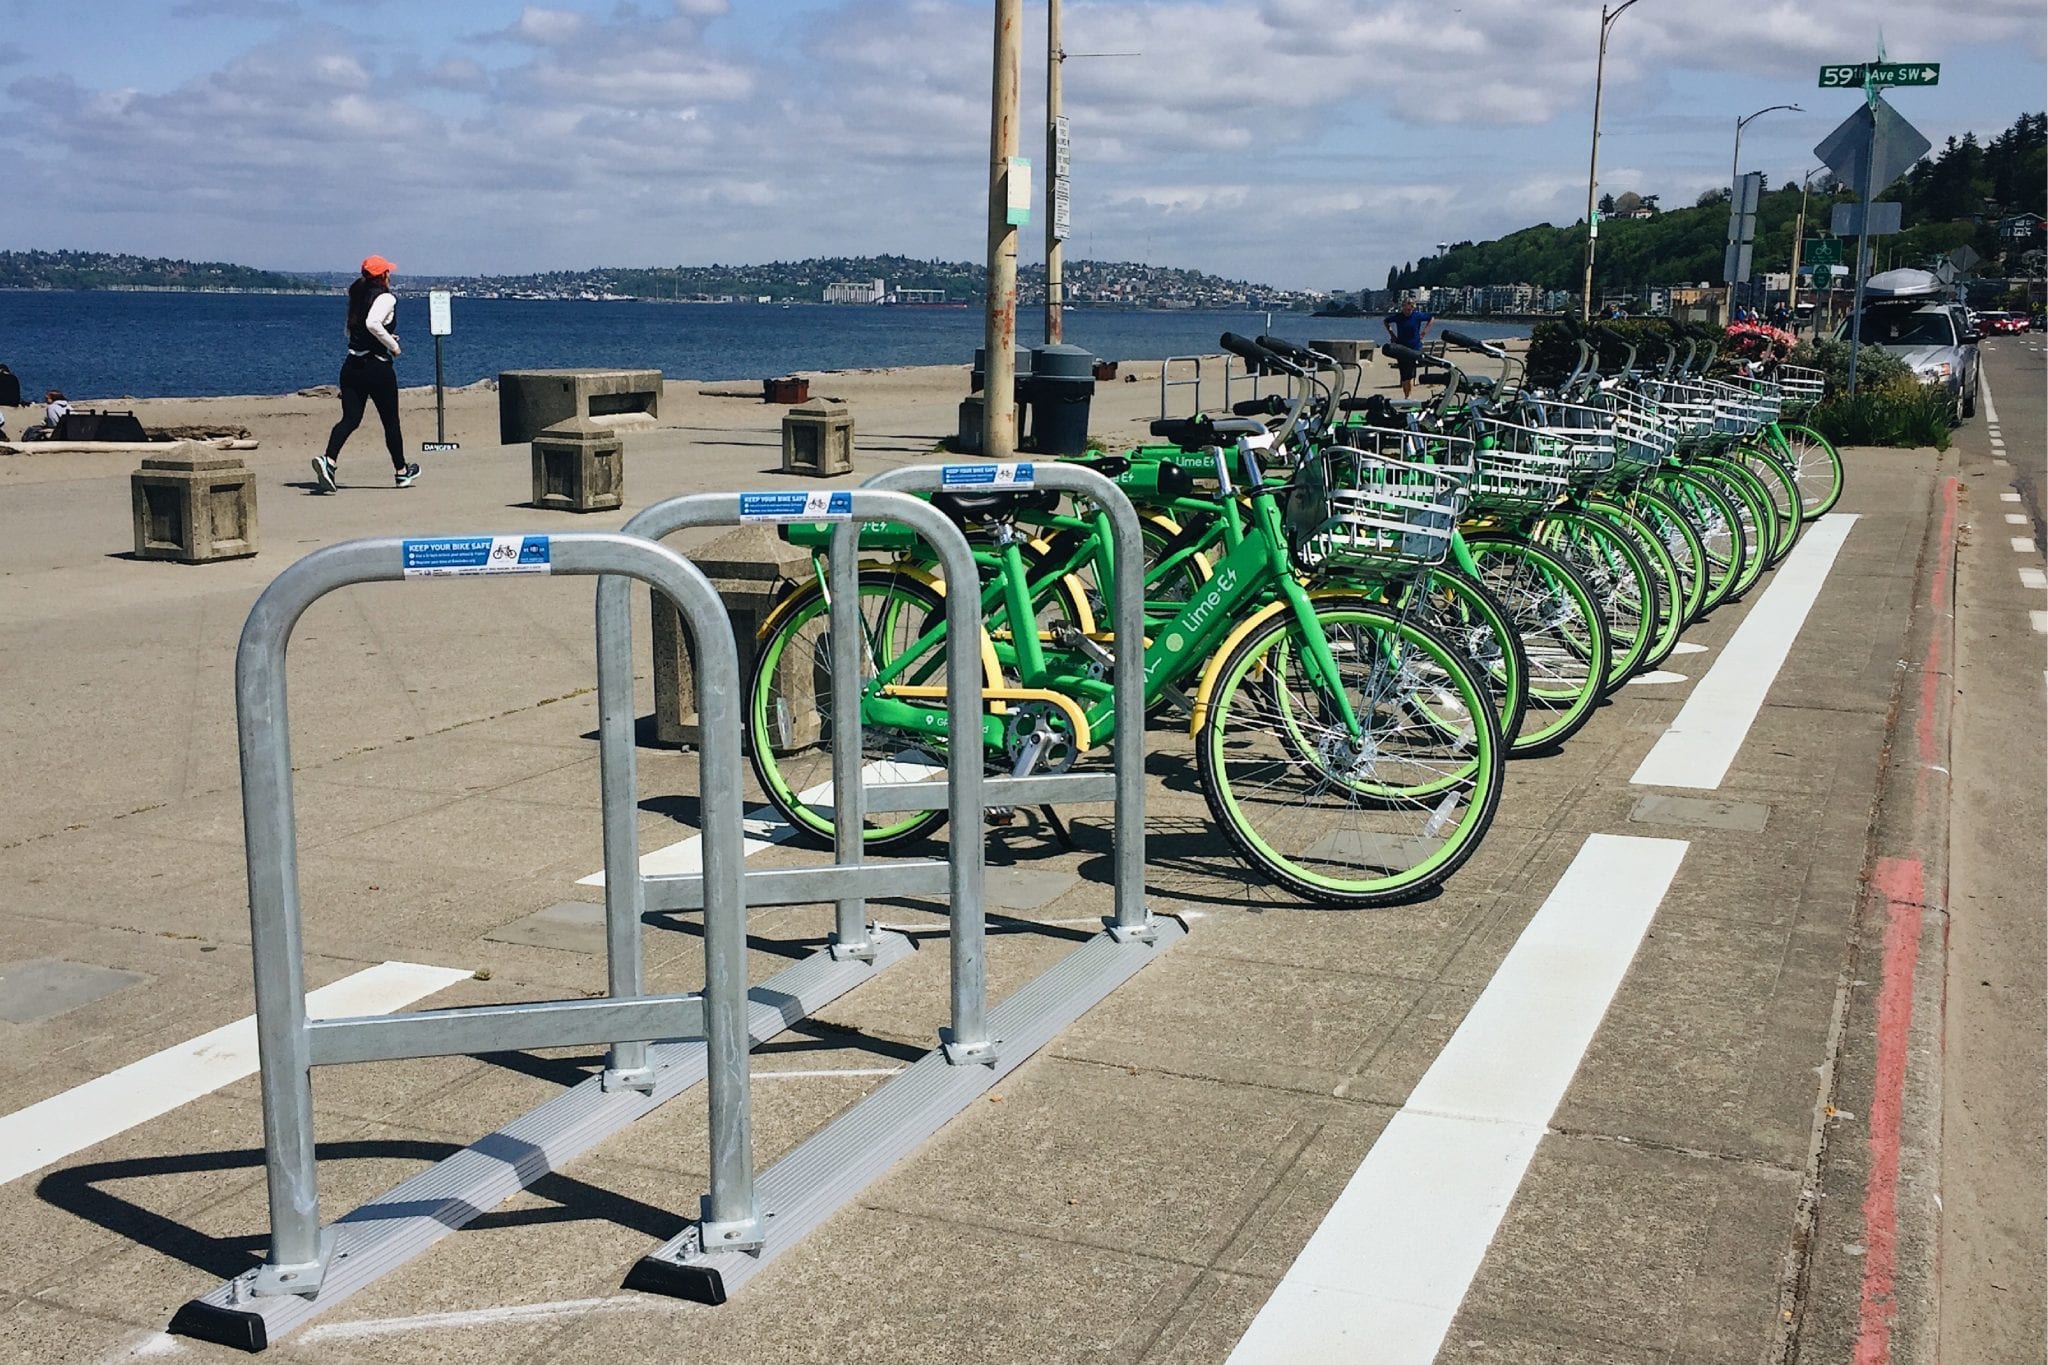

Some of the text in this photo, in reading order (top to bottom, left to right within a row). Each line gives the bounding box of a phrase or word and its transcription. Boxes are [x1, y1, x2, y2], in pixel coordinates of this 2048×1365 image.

[1870, 69, 1894, 81] Ave
[1898, 68, 1920, 80] SW
[409, 544, 429, 552] KEEP
[430, 543, 451, 551] YOUR
[471, 542, 491, 550] SAFE
